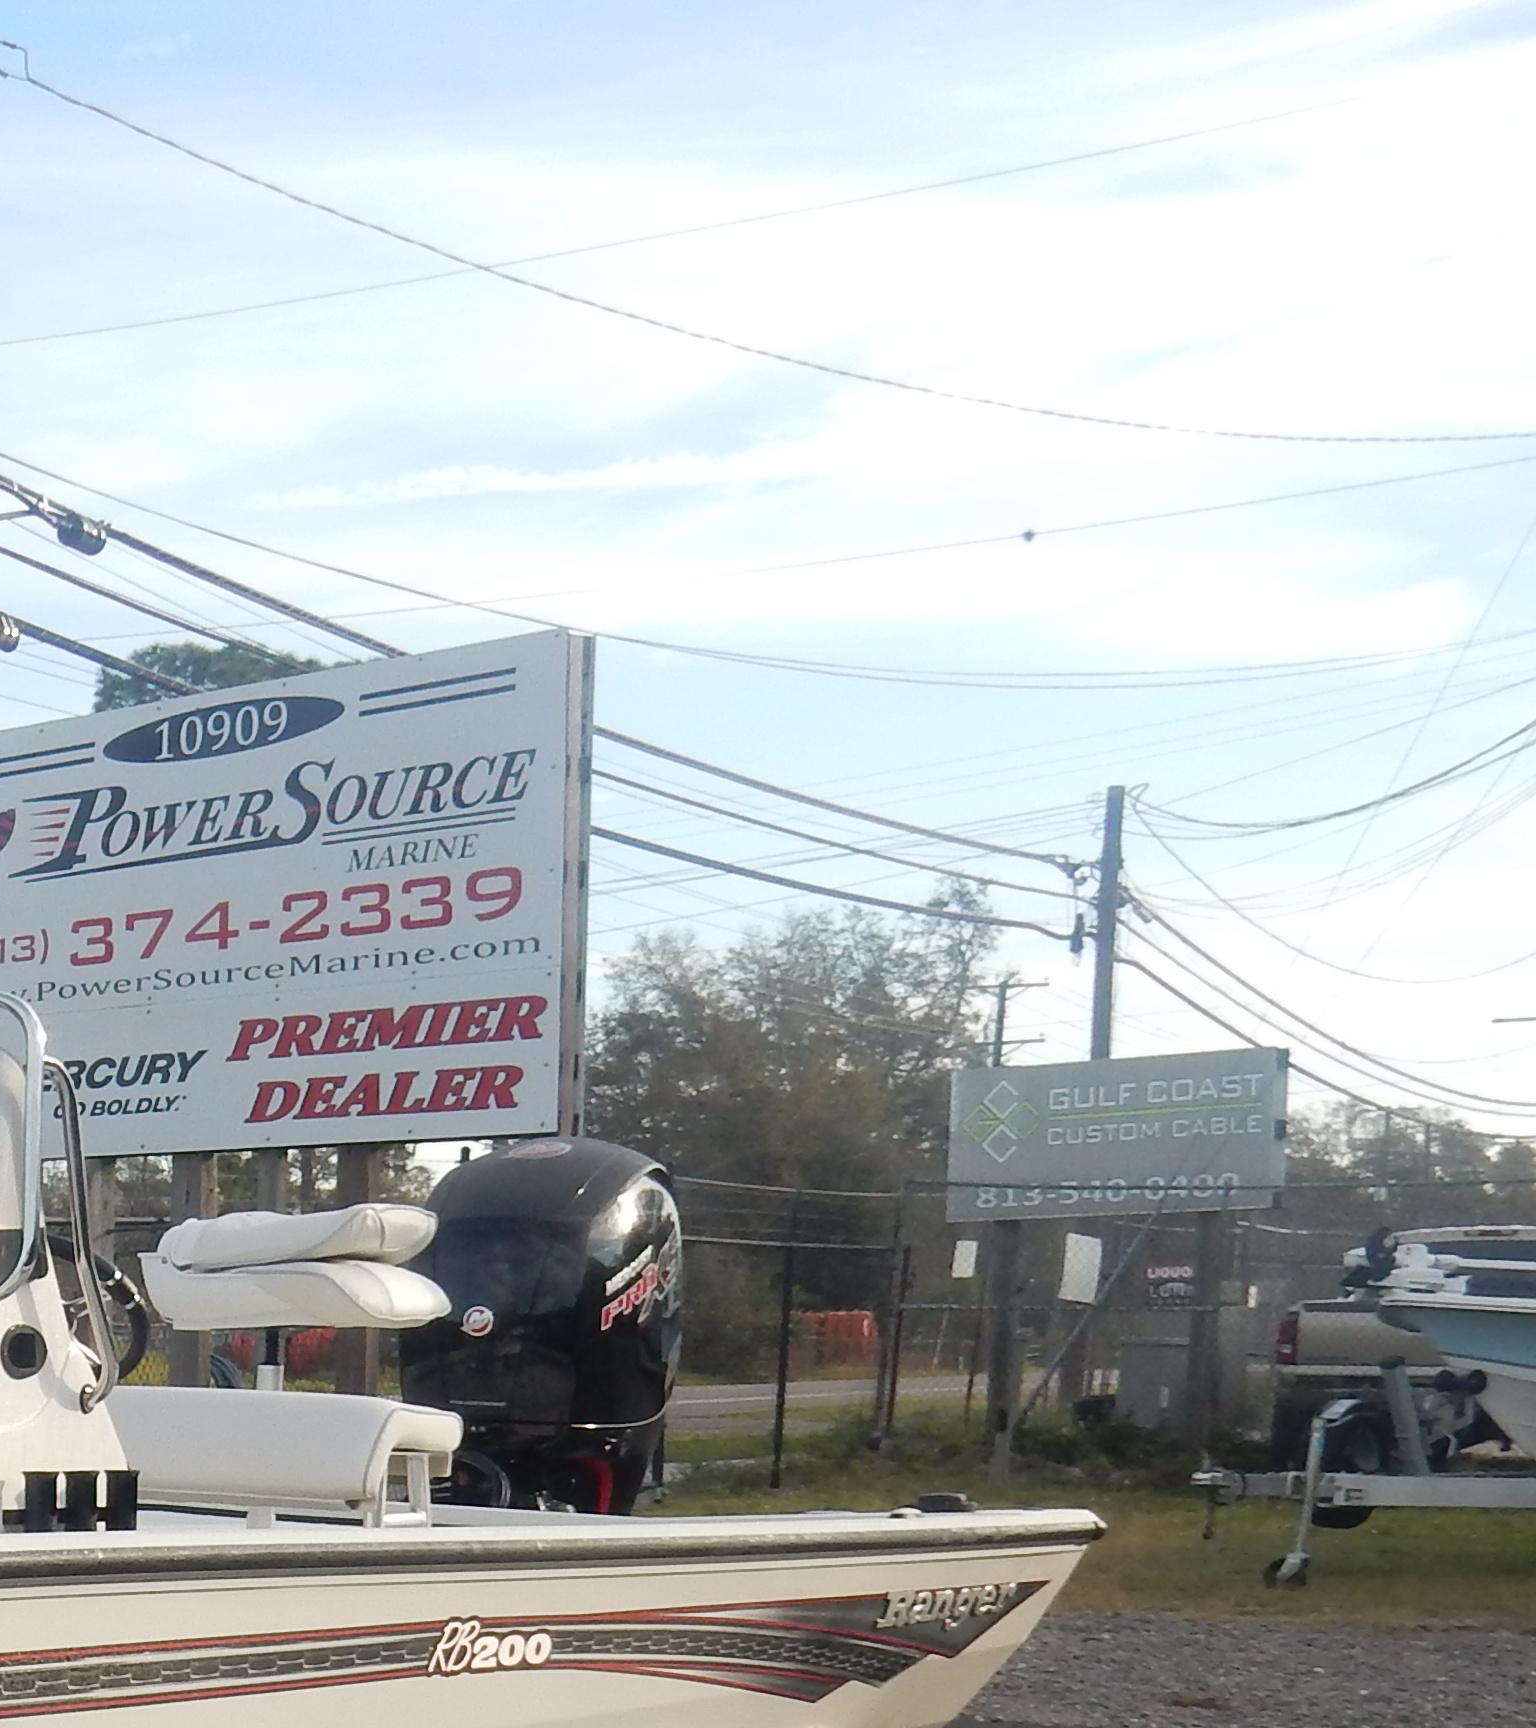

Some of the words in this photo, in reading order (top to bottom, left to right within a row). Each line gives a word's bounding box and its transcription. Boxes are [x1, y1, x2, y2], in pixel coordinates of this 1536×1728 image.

[153, 700, 289, 761] 10909
[346, 833, 479, 873] MARINE
[69, 867, 523, 967] 374-2339
[226, 994, 548, 1063] PREMIER
[42, 1050, 208, 1092] RCURY
[244, 1064, 524, 1124] DEALER
[1048, 1082, 1137, 1111] GULF
[1146, 1073, 1264, 1104] COAST
[1047, 1122, 1161, 1146] CUSTOM
[1171, 1114, 1264, 1138] CABLE
[876, 1582, 1018, 1631] Ranger
